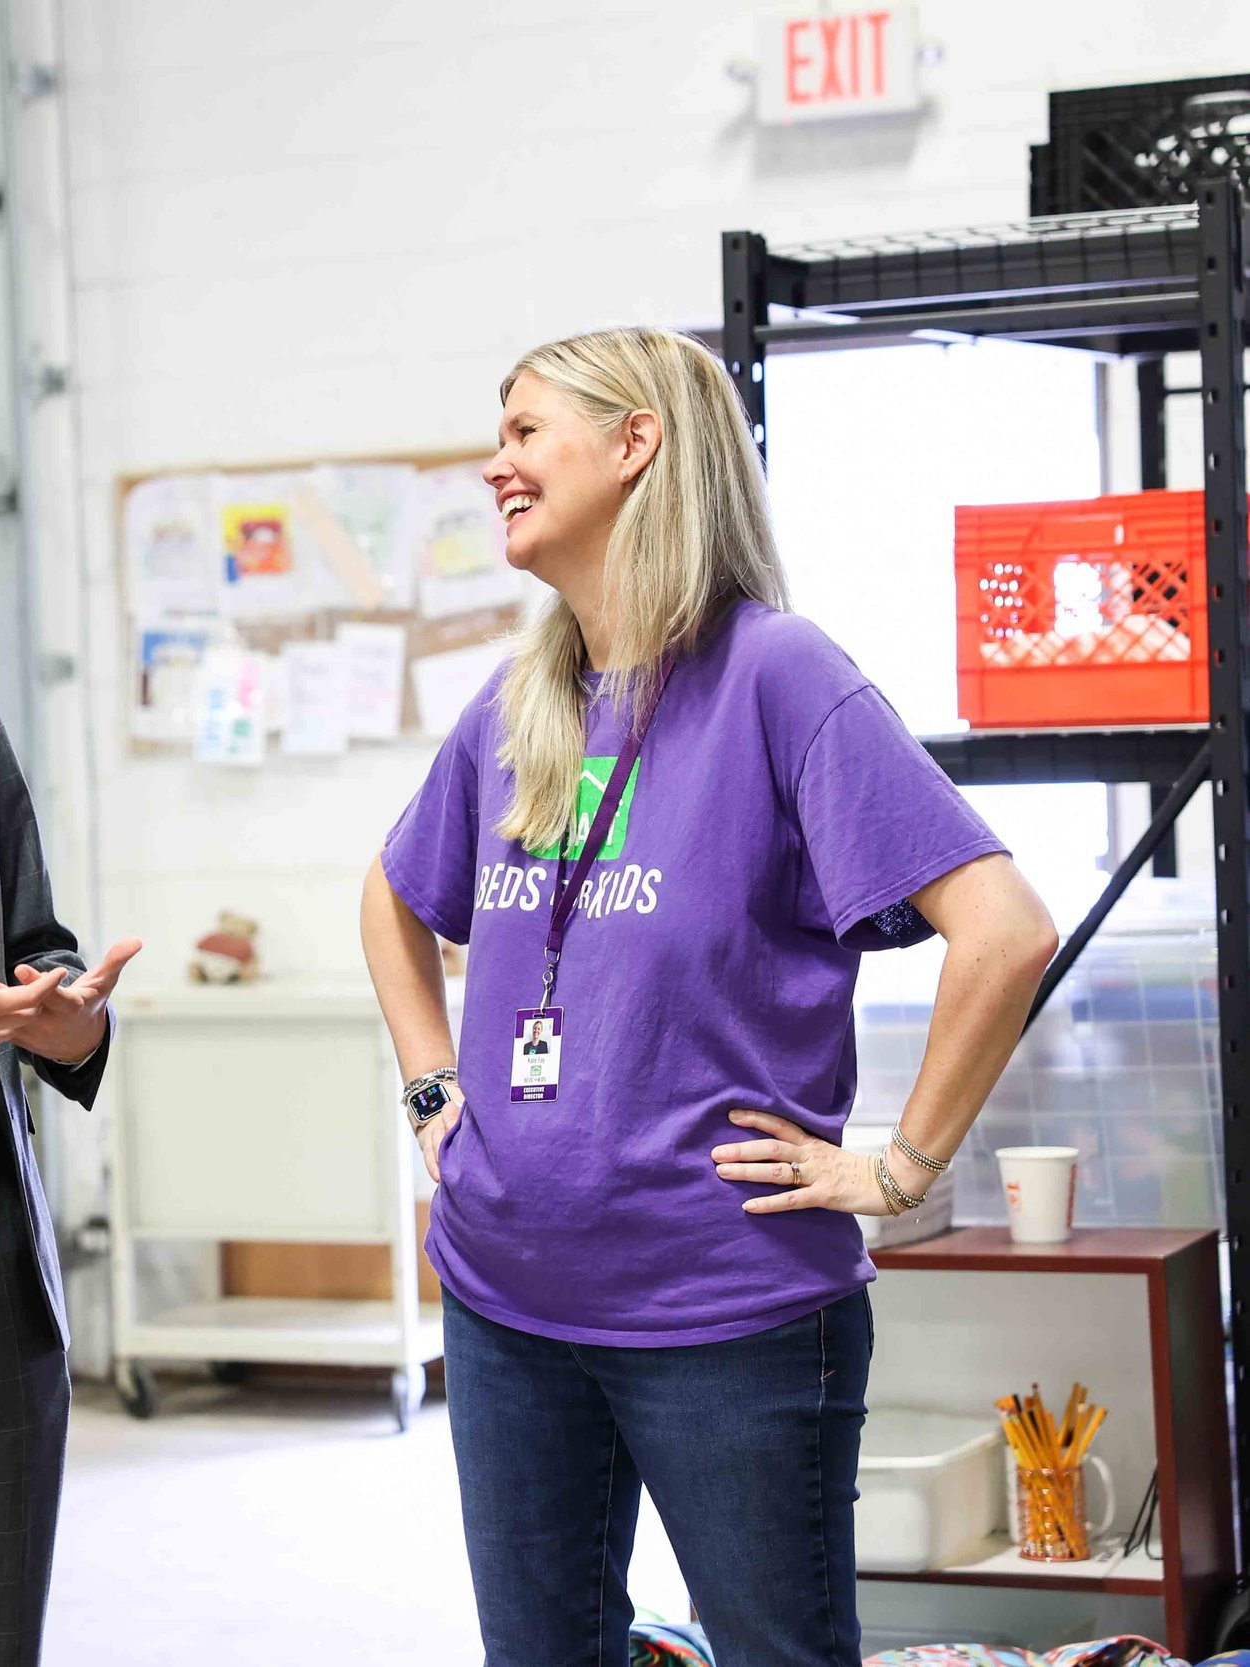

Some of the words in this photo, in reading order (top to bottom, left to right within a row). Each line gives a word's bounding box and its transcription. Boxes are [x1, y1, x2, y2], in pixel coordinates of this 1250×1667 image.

[785, 10, 892, 105] EXIT
[475, 862, 547, 911] BEDS
[587, 863, 662, 919] KIDS
